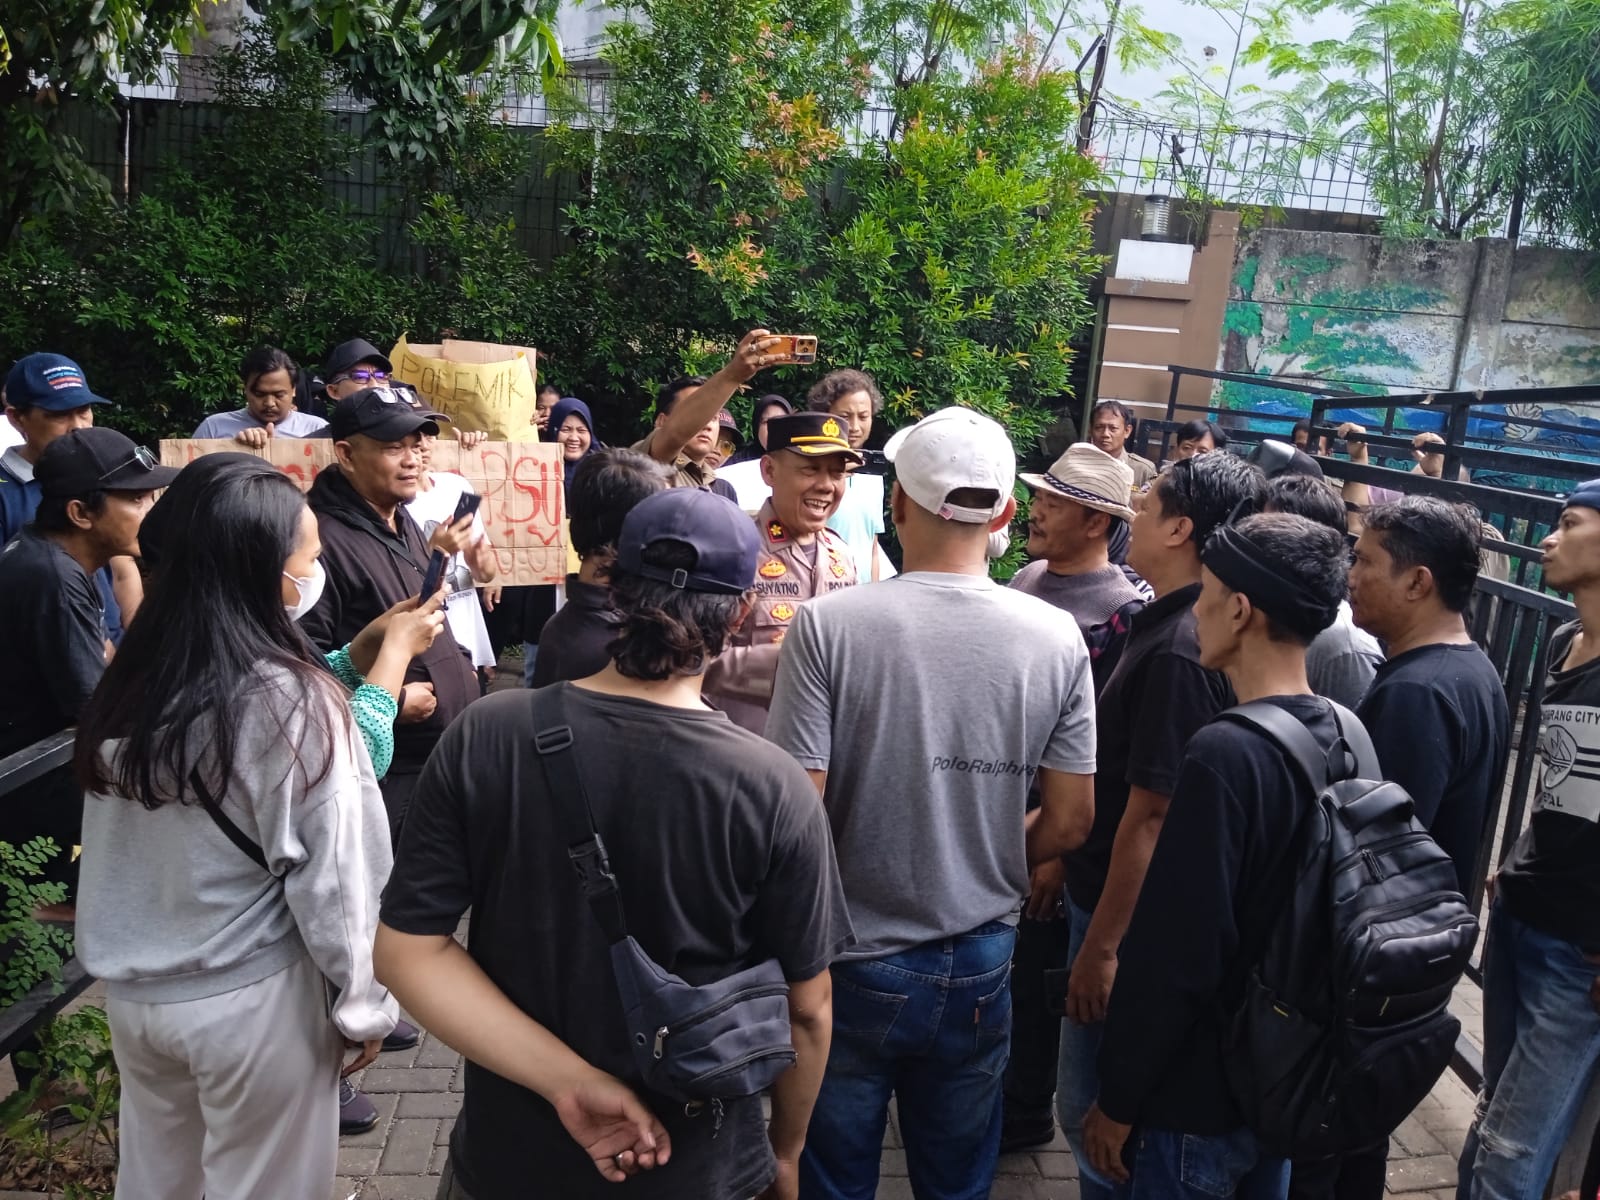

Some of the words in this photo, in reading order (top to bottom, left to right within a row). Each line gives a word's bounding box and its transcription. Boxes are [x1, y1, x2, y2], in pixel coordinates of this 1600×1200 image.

[400, 354, 524, 409] POLEMIK
[481, 450, 562, 527] PSU
[1575, 711, 1600, 725] CITY
